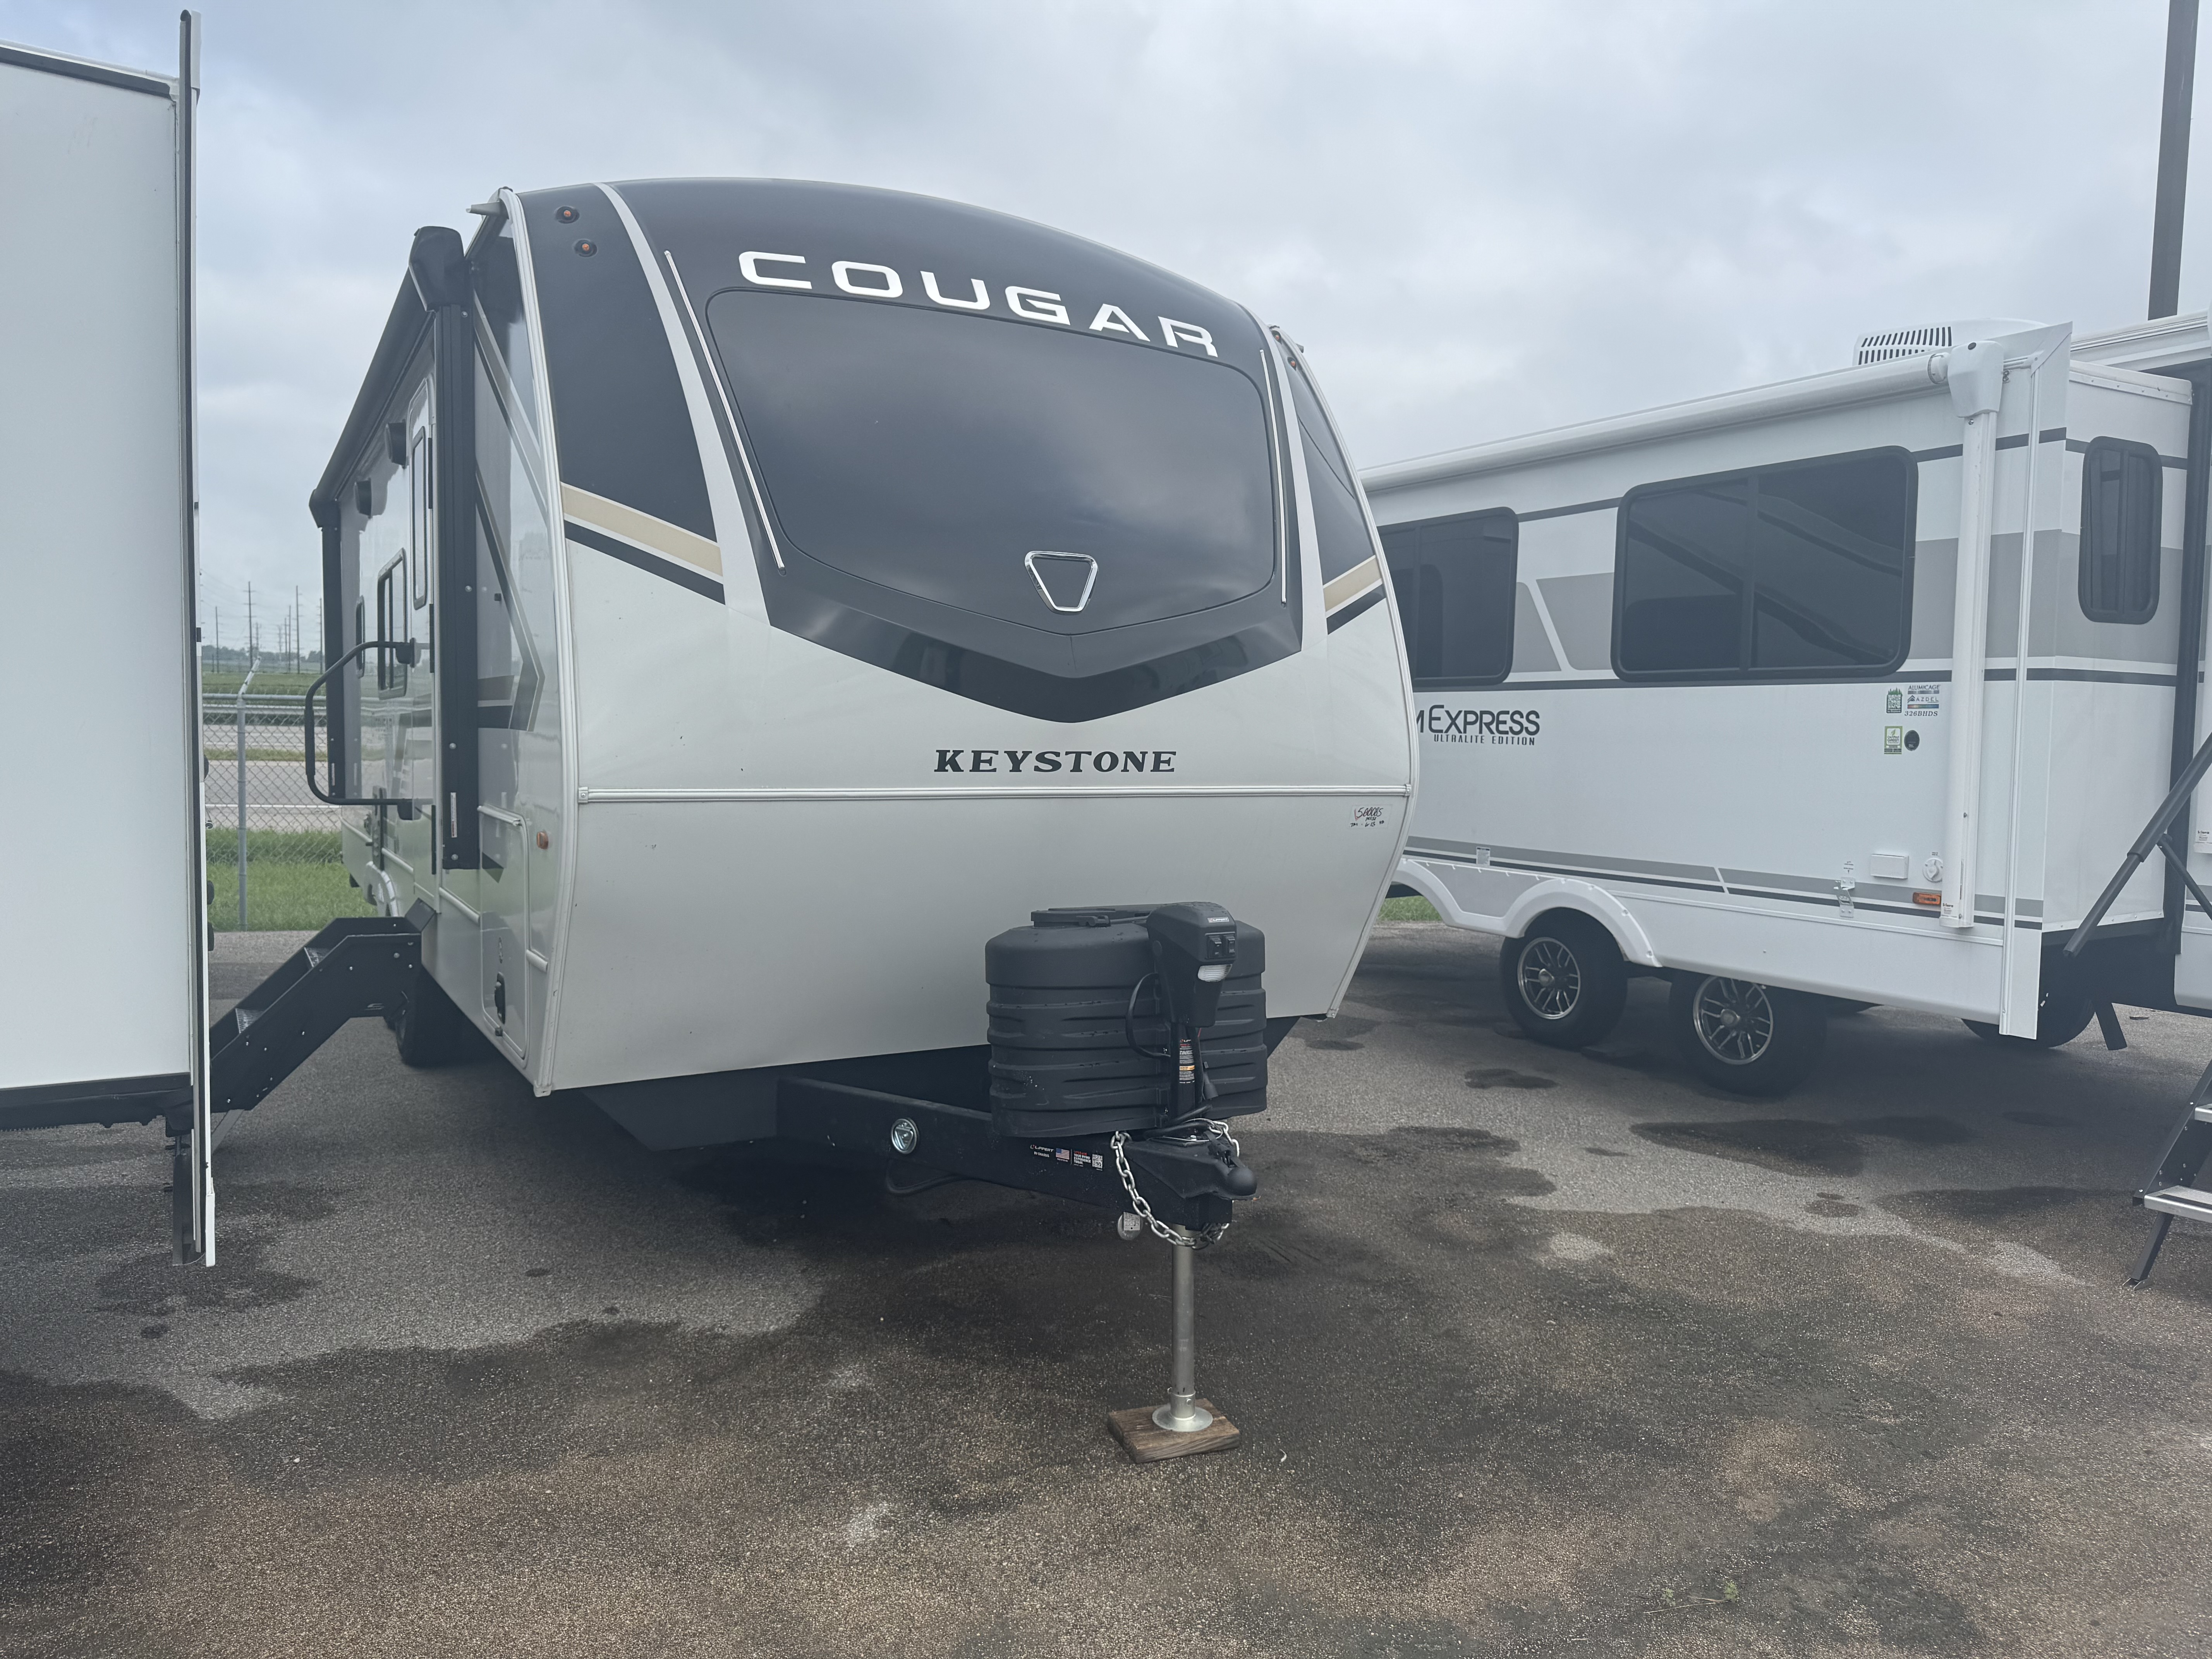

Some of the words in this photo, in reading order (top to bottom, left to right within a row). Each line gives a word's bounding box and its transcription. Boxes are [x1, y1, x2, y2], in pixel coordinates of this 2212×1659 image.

[738, 251, 1218, 357] COUGAR
[1434, 734, 1485, 744] ULTRALITE
[1492, 736, 1535, 746] EDITION
[934, 750, 1176, 773] KEYSTONE
